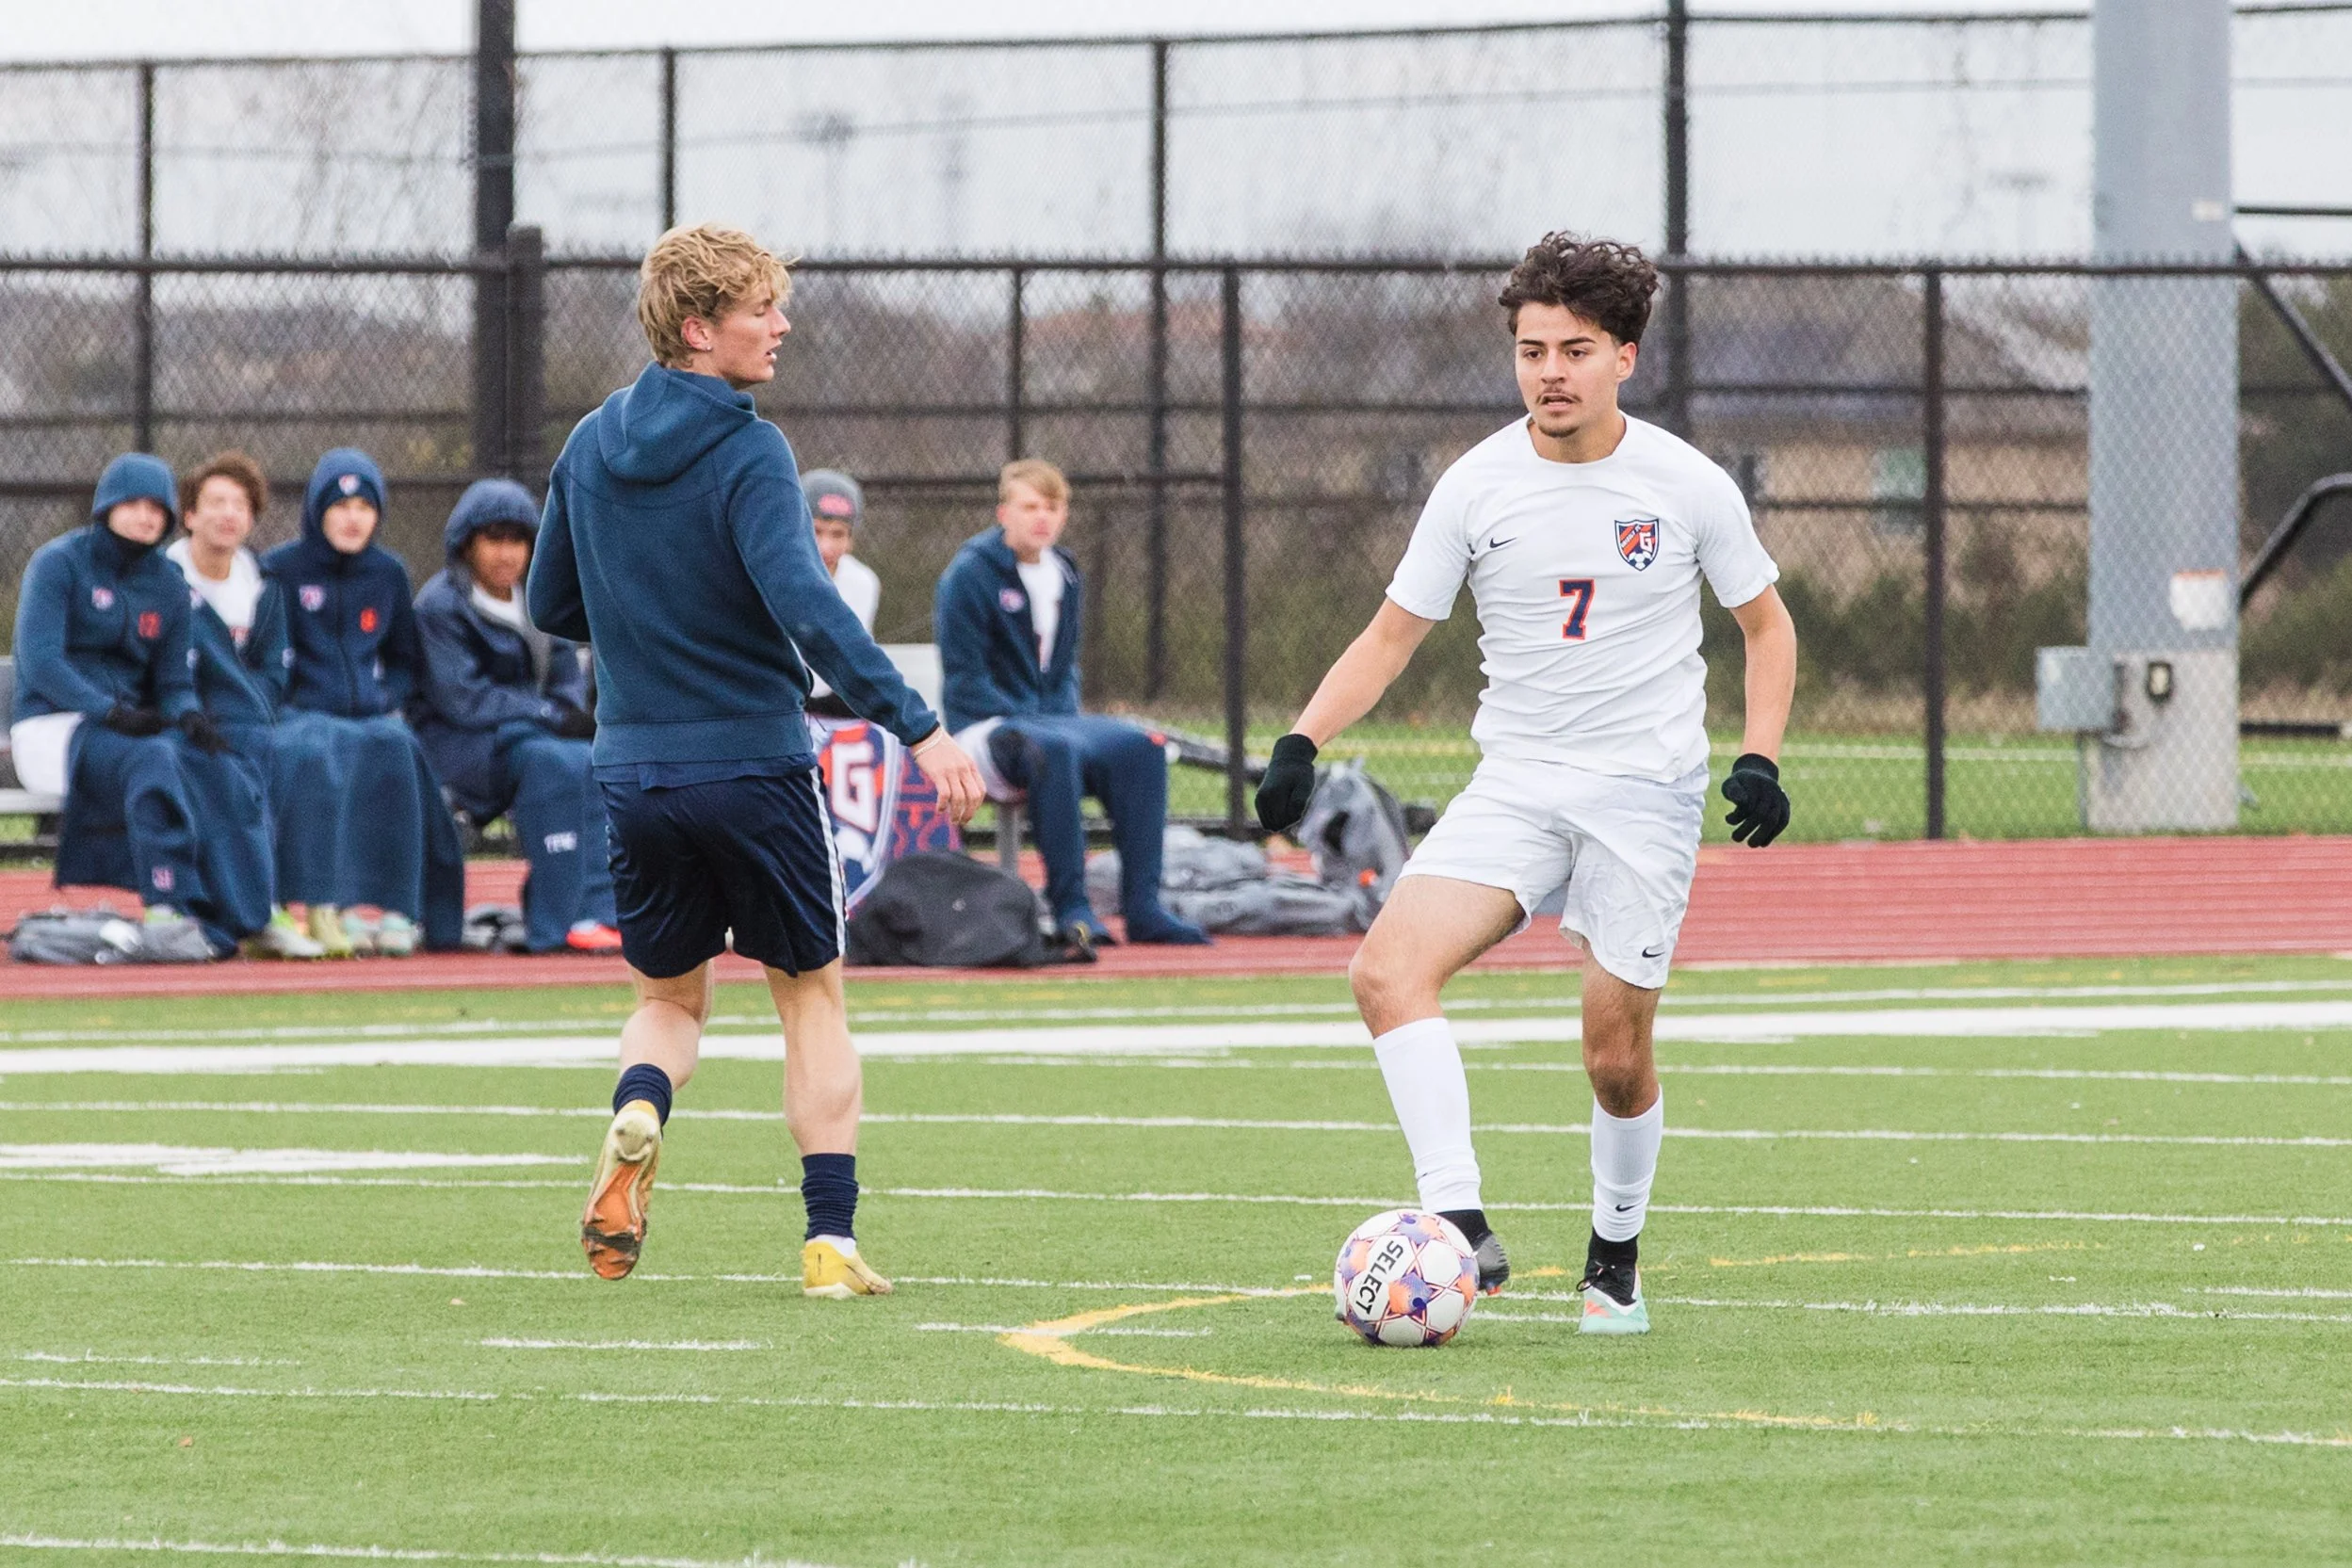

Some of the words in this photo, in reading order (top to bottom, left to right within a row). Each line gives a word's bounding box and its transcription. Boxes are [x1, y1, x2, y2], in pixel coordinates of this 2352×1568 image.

[1639, 531, 1654, 554] G
[1559, 578, 1595, 639] 7
[830, 738, 878, 833] G
[1354, 1239, 1404, 1316] SELECT
